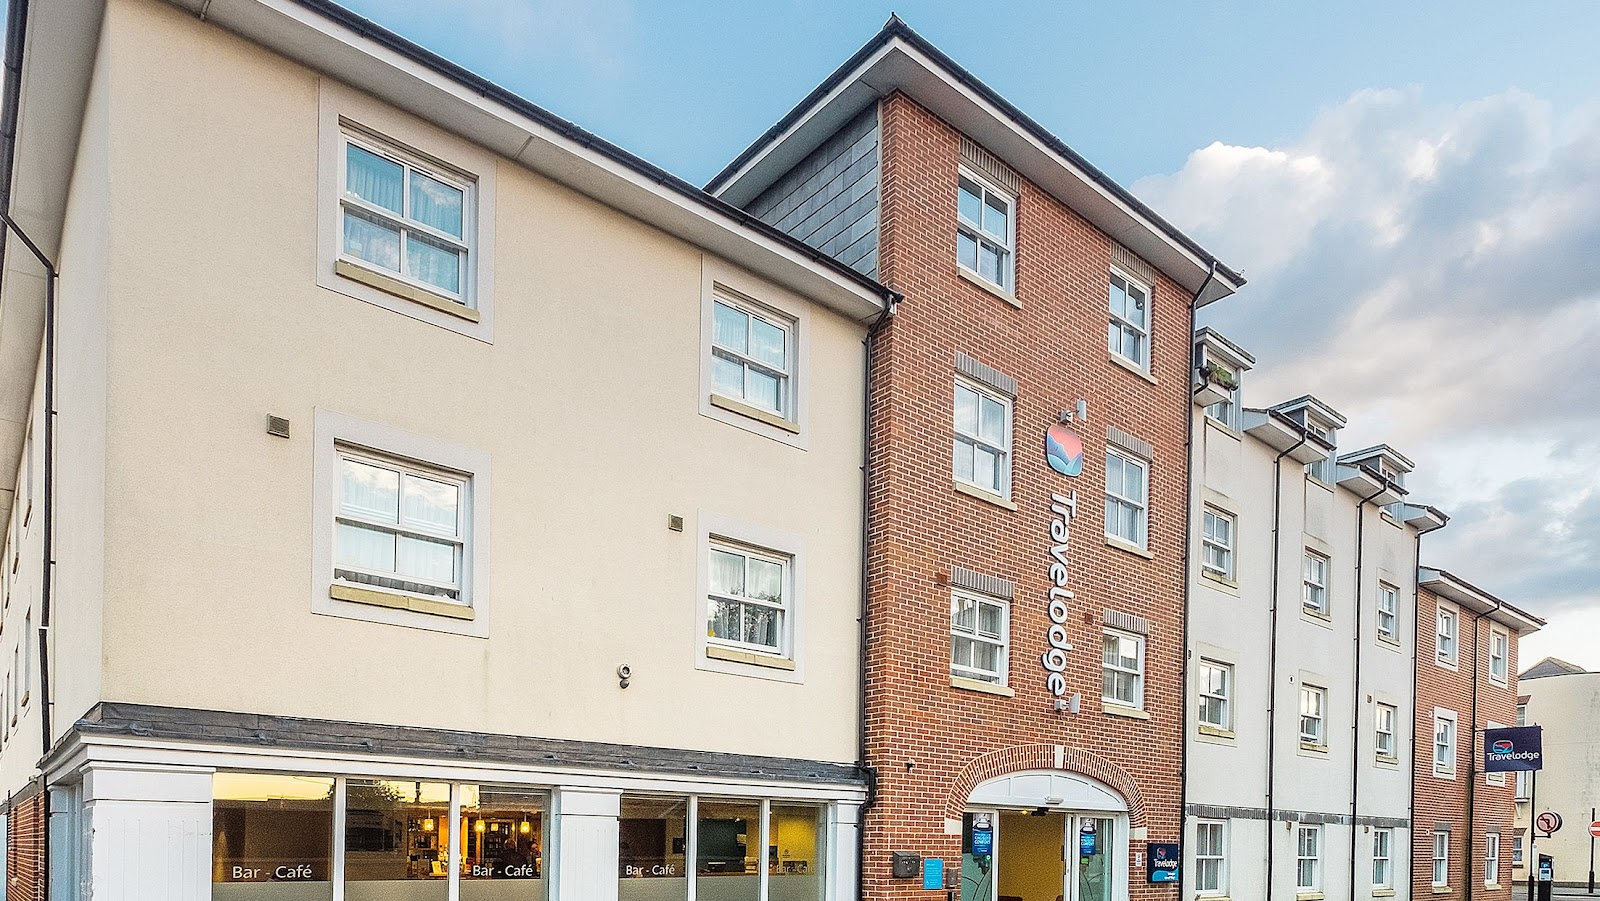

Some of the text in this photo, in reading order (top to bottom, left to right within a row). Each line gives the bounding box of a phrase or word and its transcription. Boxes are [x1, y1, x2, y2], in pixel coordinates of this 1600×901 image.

[1041, 490, 1077, 696] Travelodge
[1486, 751, 1540, 761] Travelodge
[625, 864, 644, 876] Bar
[651, 864, 676, 876] Café
[1153, 858, 1178, 870] Travelodge
[232, 865, 261, 879] Bar
[275, 864, 313, 879] Café
[472, 865, 495, 877] Bar
[504, 864, 534, 877] Café
